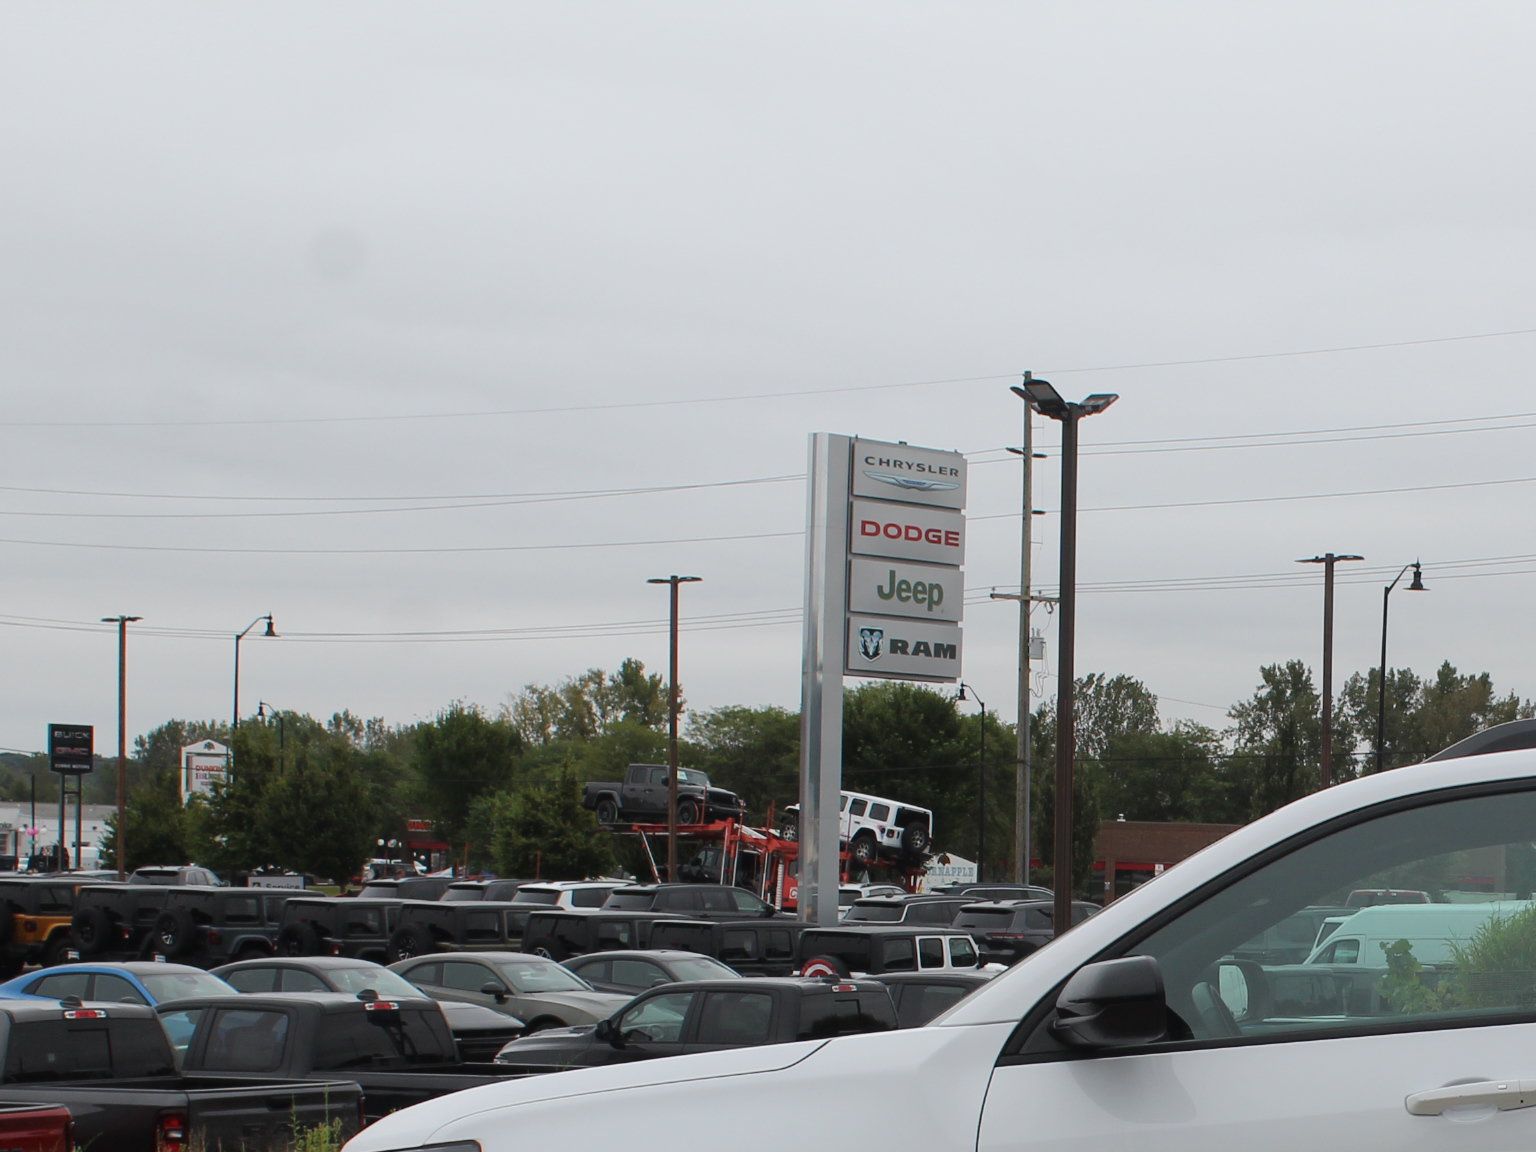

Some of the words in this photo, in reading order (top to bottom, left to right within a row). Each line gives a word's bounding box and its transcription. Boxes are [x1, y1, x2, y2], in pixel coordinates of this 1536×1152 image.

[864, 455, 959, 478] CHRYSLER
[860, 519, 960, 547] DODGE
[877, 569, 944, 612] Jeep
[889, 638, 957, 660] RAM
[54, 730, 90, 739] BUICK
